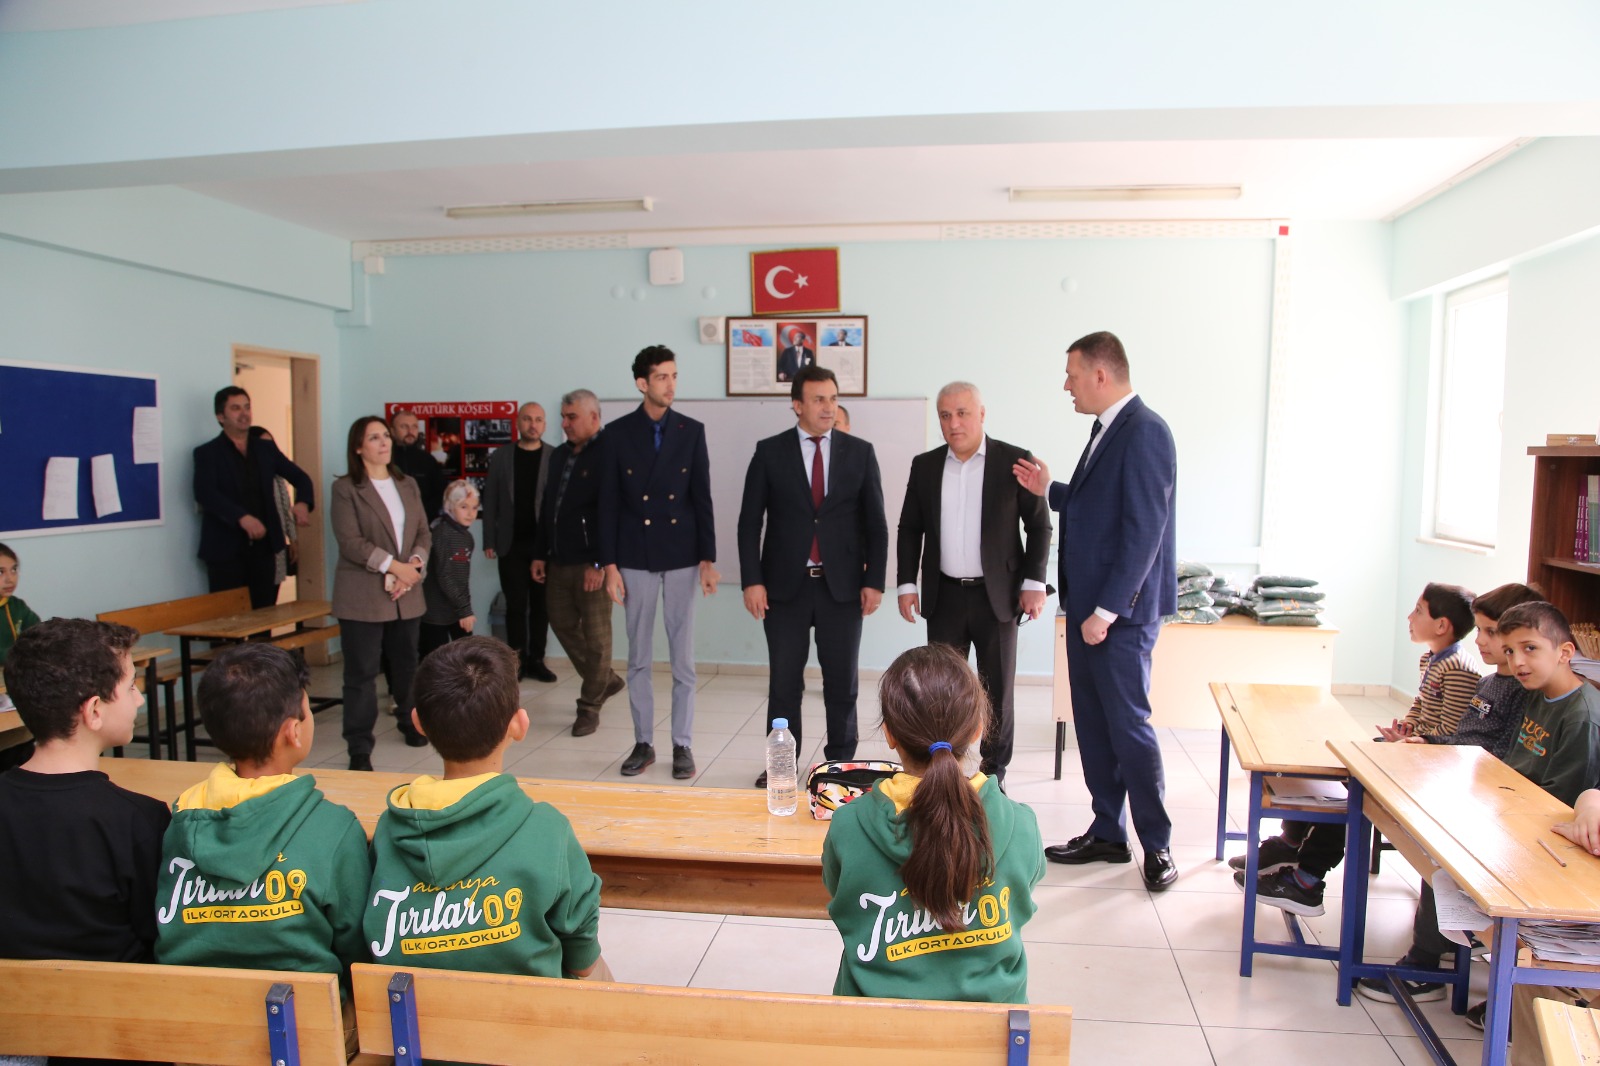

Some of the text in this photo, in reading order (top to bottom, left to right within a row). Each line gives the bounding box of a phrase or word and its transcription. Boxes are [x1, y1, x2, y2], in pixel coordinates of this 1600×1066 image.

[411, 401, 493, 416] ATATÜRK KÖŞESİ
[265, 869, 307, 903] 09
[482, 887, 524, 927] 09
[977, 886, 1011, 928] 09
